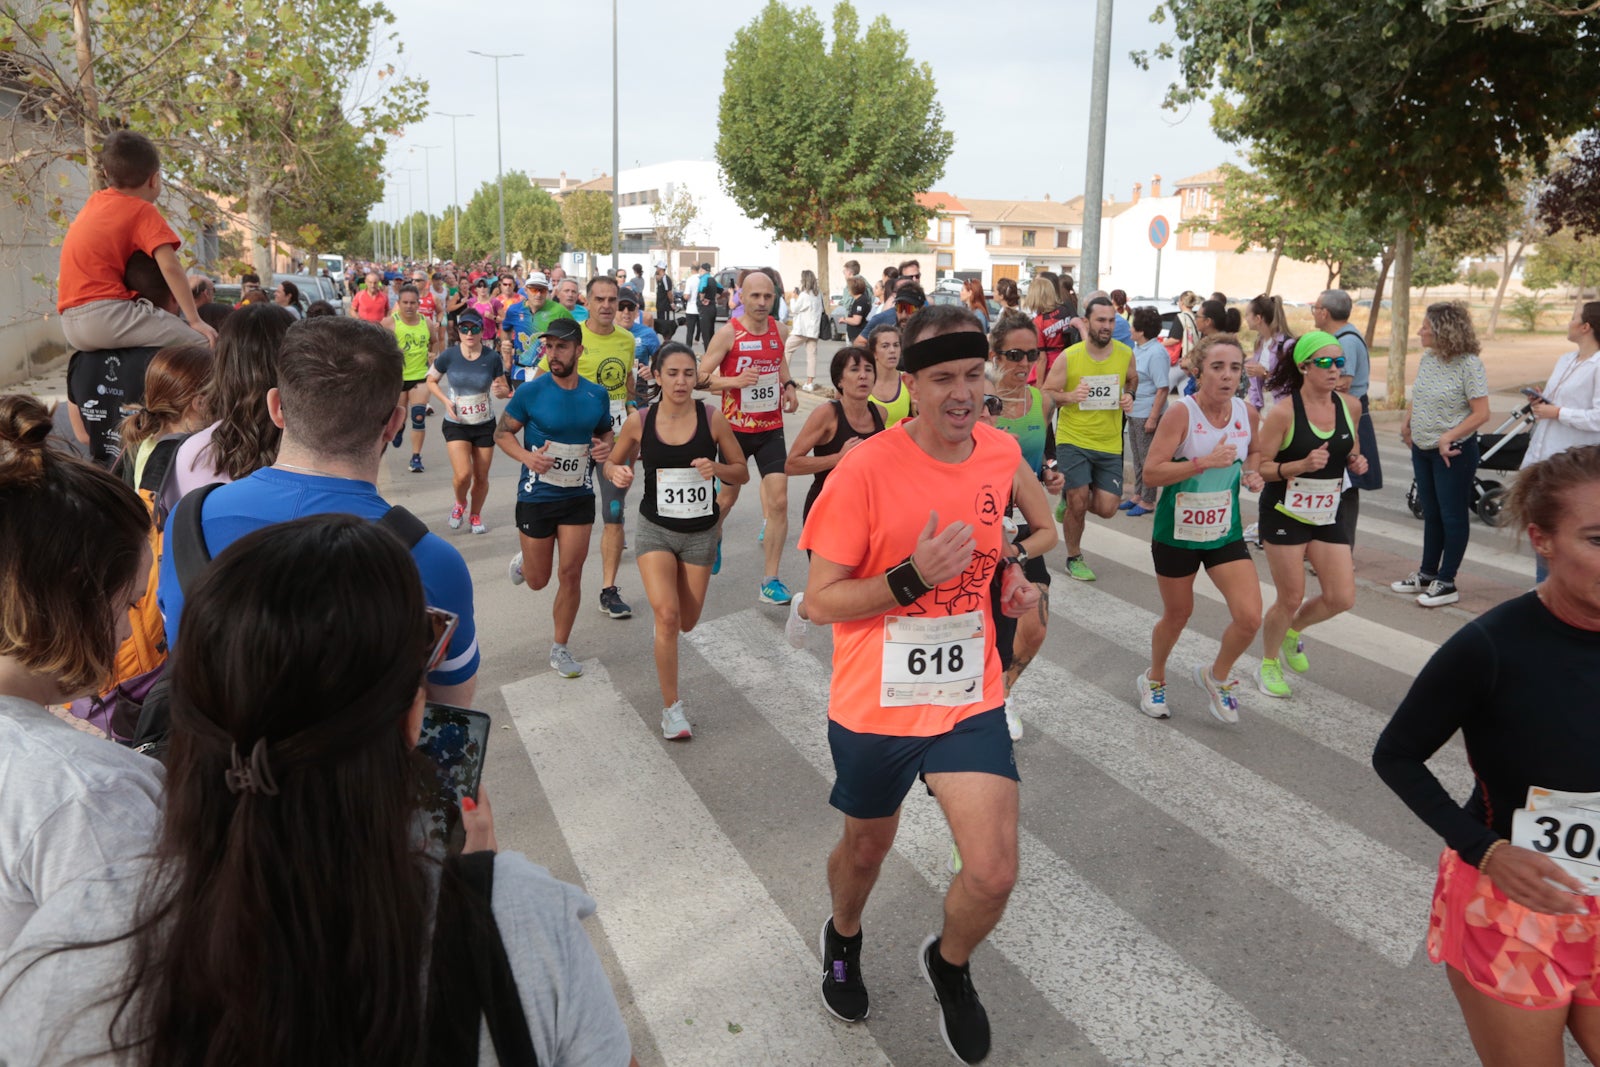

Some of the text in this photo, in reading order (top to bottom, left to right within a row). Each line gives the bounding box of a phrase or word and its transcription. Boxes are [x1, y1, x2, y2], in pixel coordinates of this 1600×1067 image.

[574, 253, 583, 263] P
[751, 387, 774, 400] 385
[1088, 386, 1111, 398] 562
[460, 403, 487, 415] 2138
[610, 414, 622, 427] 91
[553, 457, 579, 472] 566
[665, 486, 707, 504] 3130
[1291, 493, 1334, 509] 2173
[1182, 508, 1227, 525] 2087
[907, 644, 964, 676] 618
[1531, 816, 1600, 862] 30
